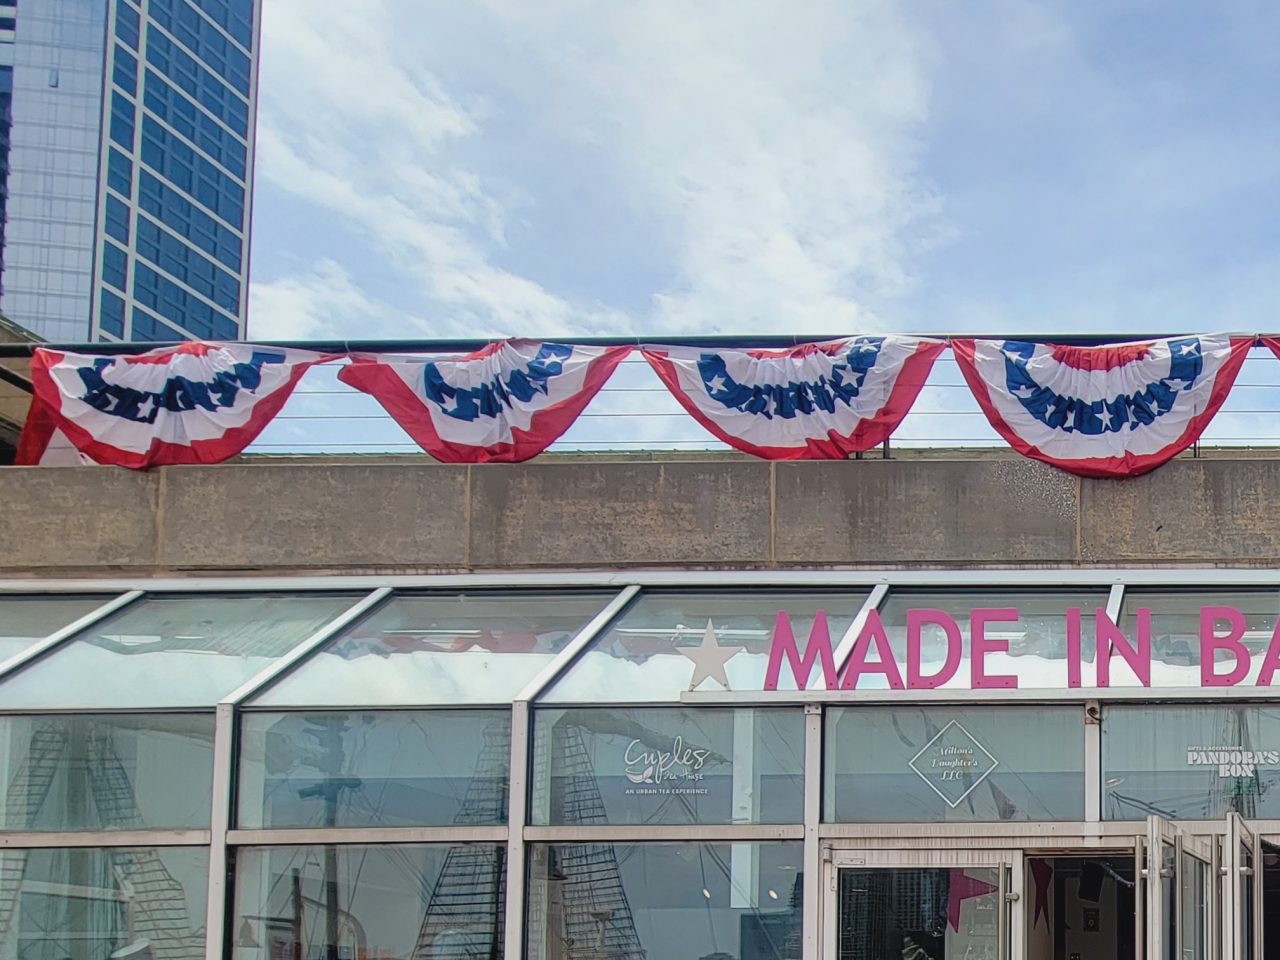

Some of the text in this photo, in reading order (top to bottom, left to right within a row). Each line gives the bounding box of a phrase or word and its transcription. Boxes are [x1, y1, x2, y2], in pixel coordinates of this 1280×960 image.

[763, 607, 1018, 691] MADE
[1066, 606, 1151, 689] IN
[1187, 751, 1280, 765] PANDORA'S
[940, 769, 964, 781] LLC
[1219, 764, 1254, 777] BOX
